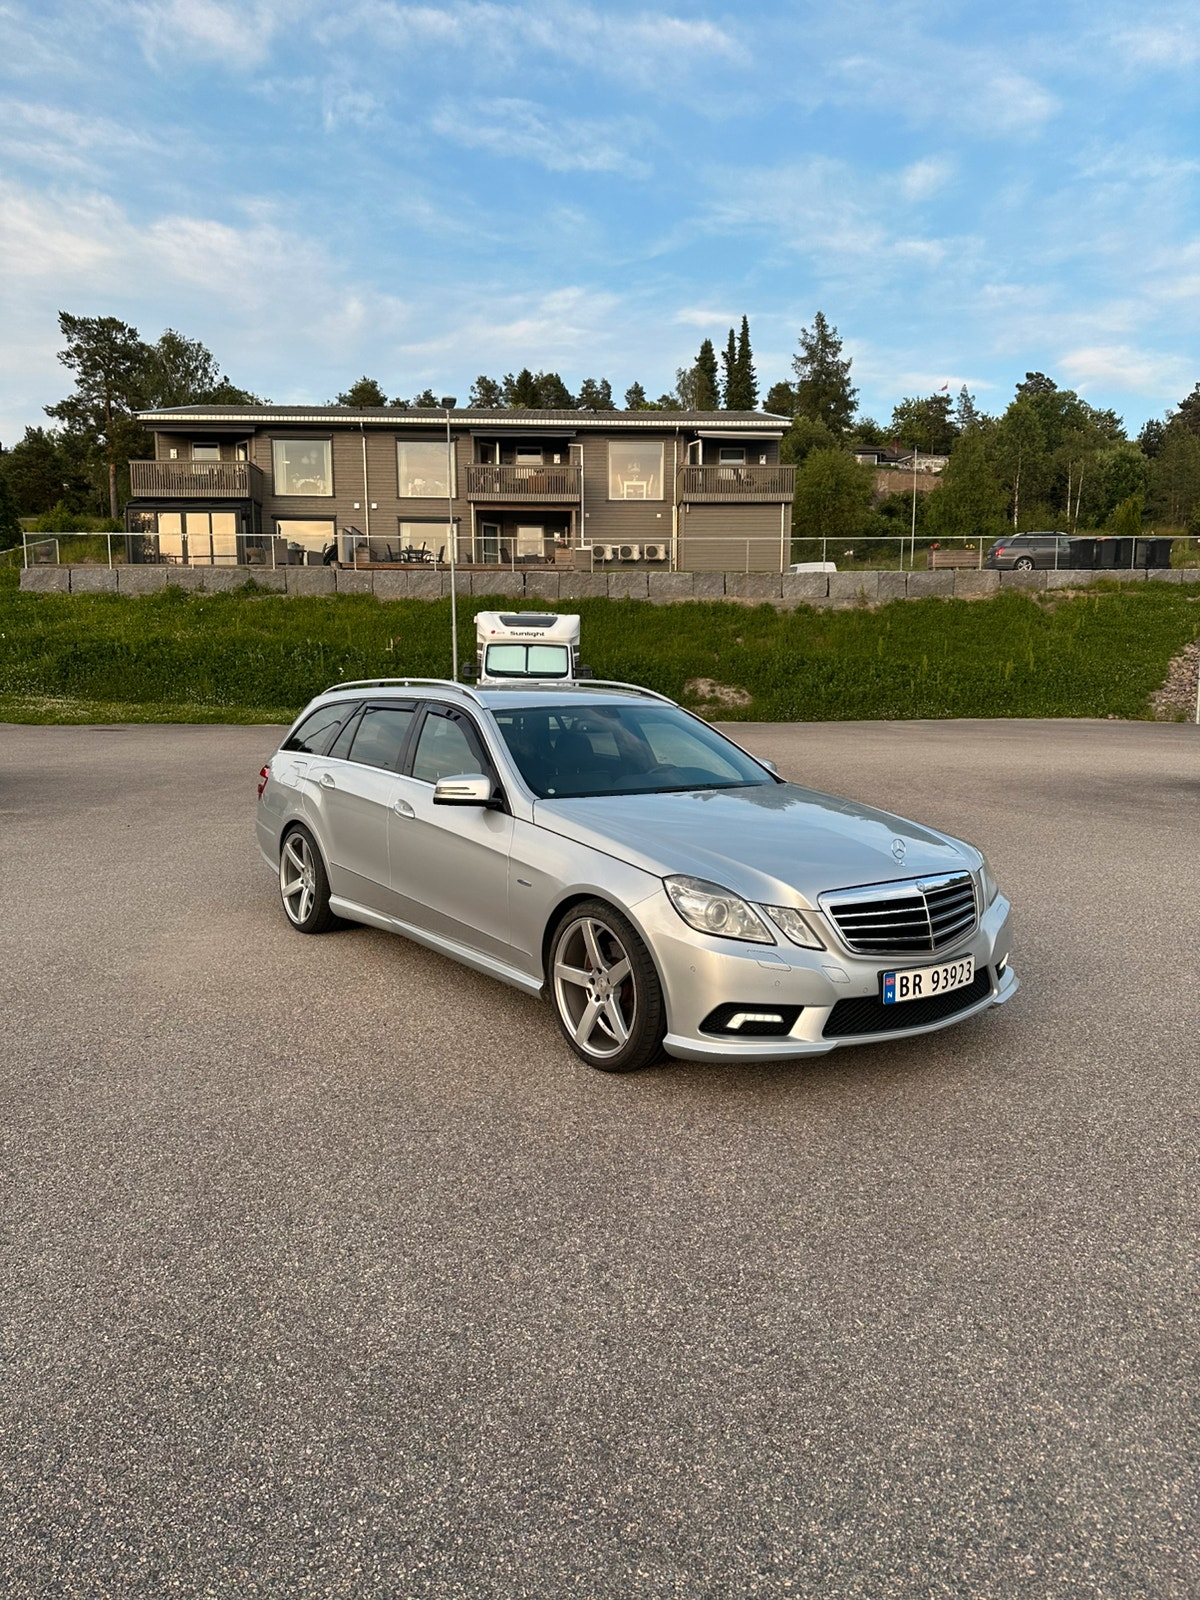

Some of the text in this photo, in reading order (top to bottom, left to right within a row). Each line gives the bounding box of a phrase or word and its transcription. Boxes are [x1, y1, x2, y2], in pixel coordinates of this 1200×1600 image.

[899, 960, 972, 998] BR 93923
[887, 991, 893, 999] N
